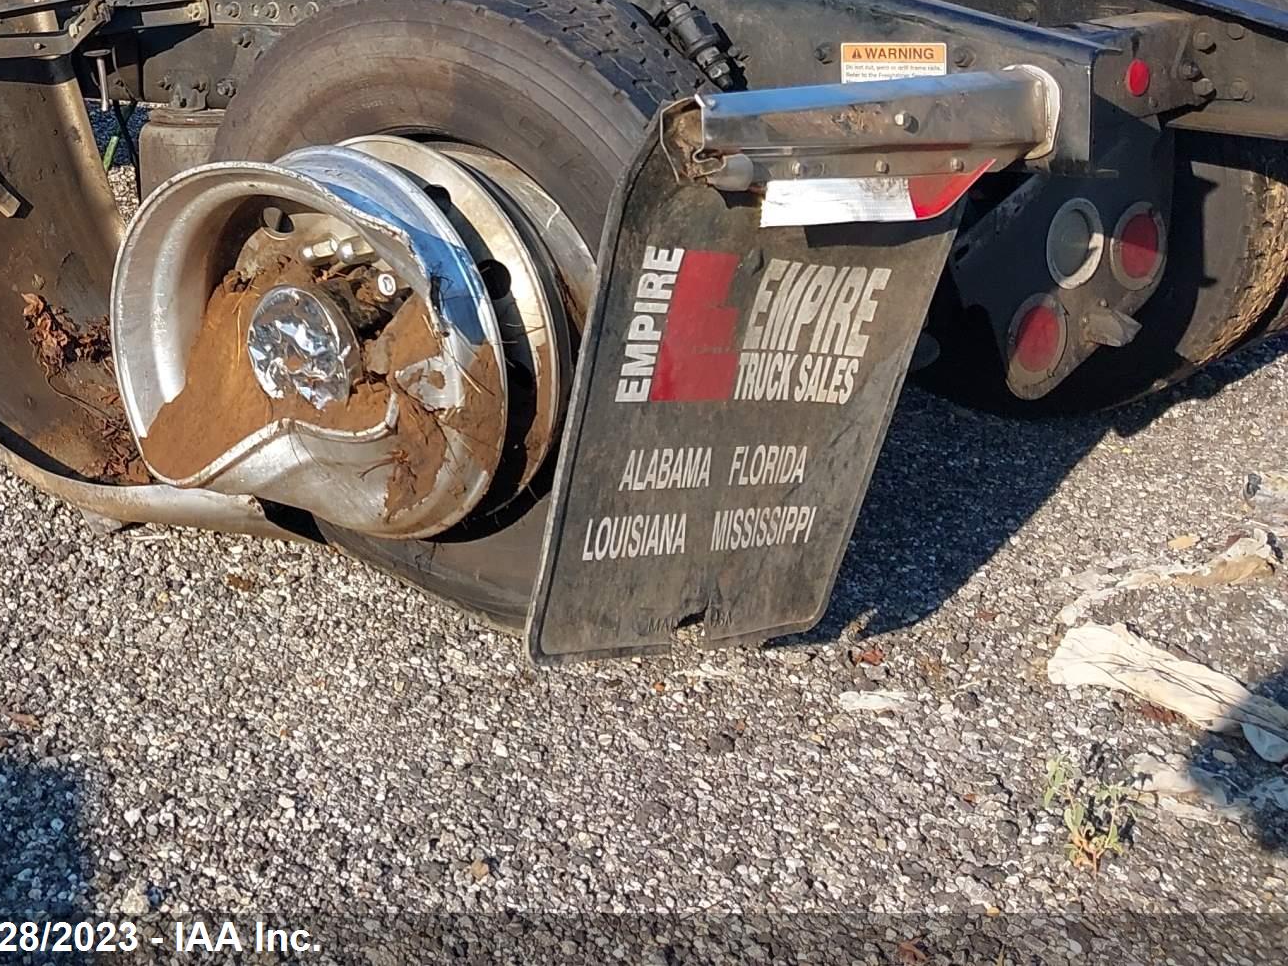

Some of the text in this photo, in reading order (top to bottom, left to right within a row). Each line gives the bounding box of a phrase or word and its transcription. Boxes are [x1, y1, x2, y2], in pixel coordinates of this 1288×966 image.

[865, 48, 934, 60] WARNING
[614, 245, 686, 403] EMPIRE
[741, 258, 892, 358] EMPIRE
[733, 351, 860, 405] TRUCK SALES
[618, 444, 808, 492] ALABAMA FLORIDA
[581, 505, 818, 561] LOUISIANA MISSISSIPPI
